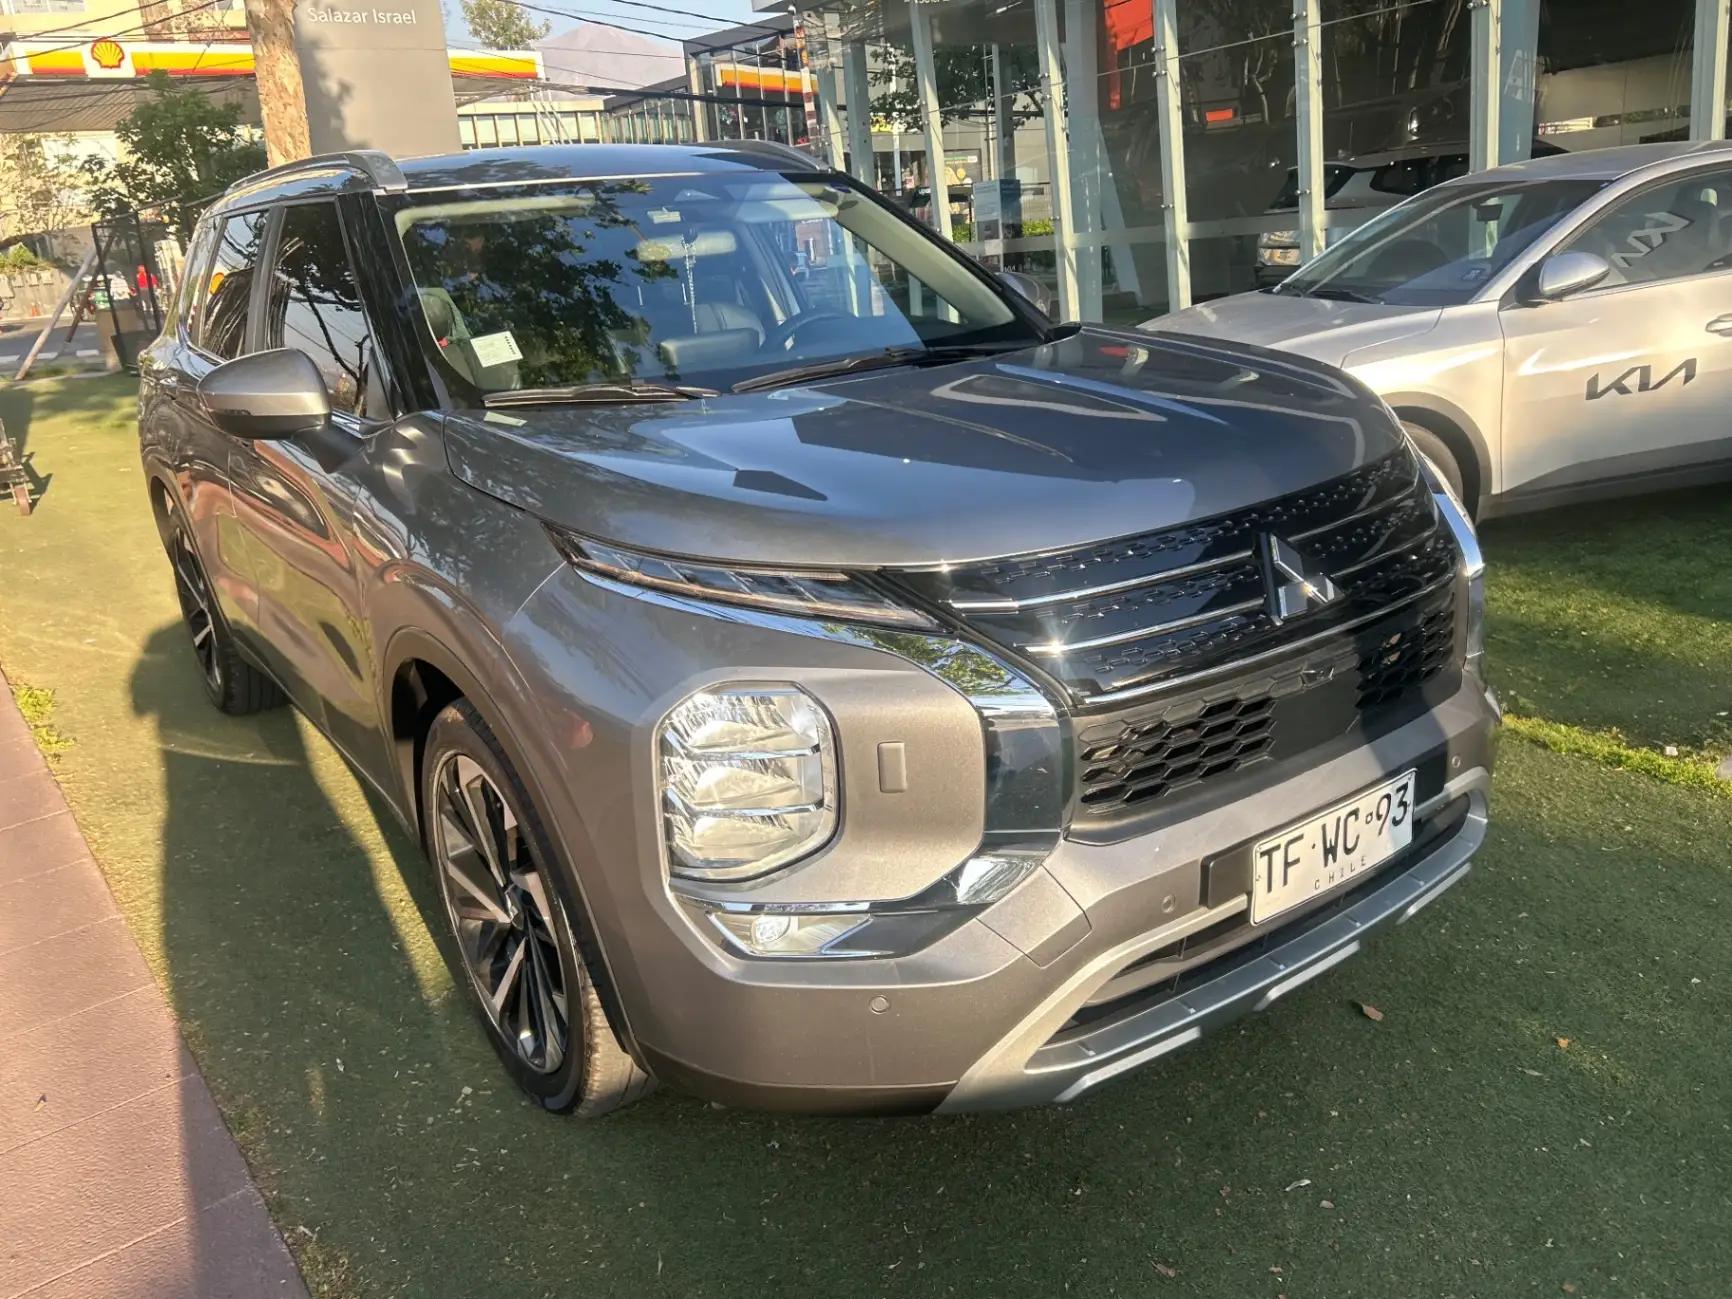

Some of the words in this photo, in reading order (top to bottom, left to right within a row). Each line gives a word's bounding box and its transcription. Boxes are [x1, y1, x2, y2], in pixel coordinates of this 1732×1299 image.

[307, 7, 368, 23] Salazar
[372, 8, 416, 24] Israel
[1585, 357, 1697, 400] KIA
[1314, 855, 1367, 890] CHILE
